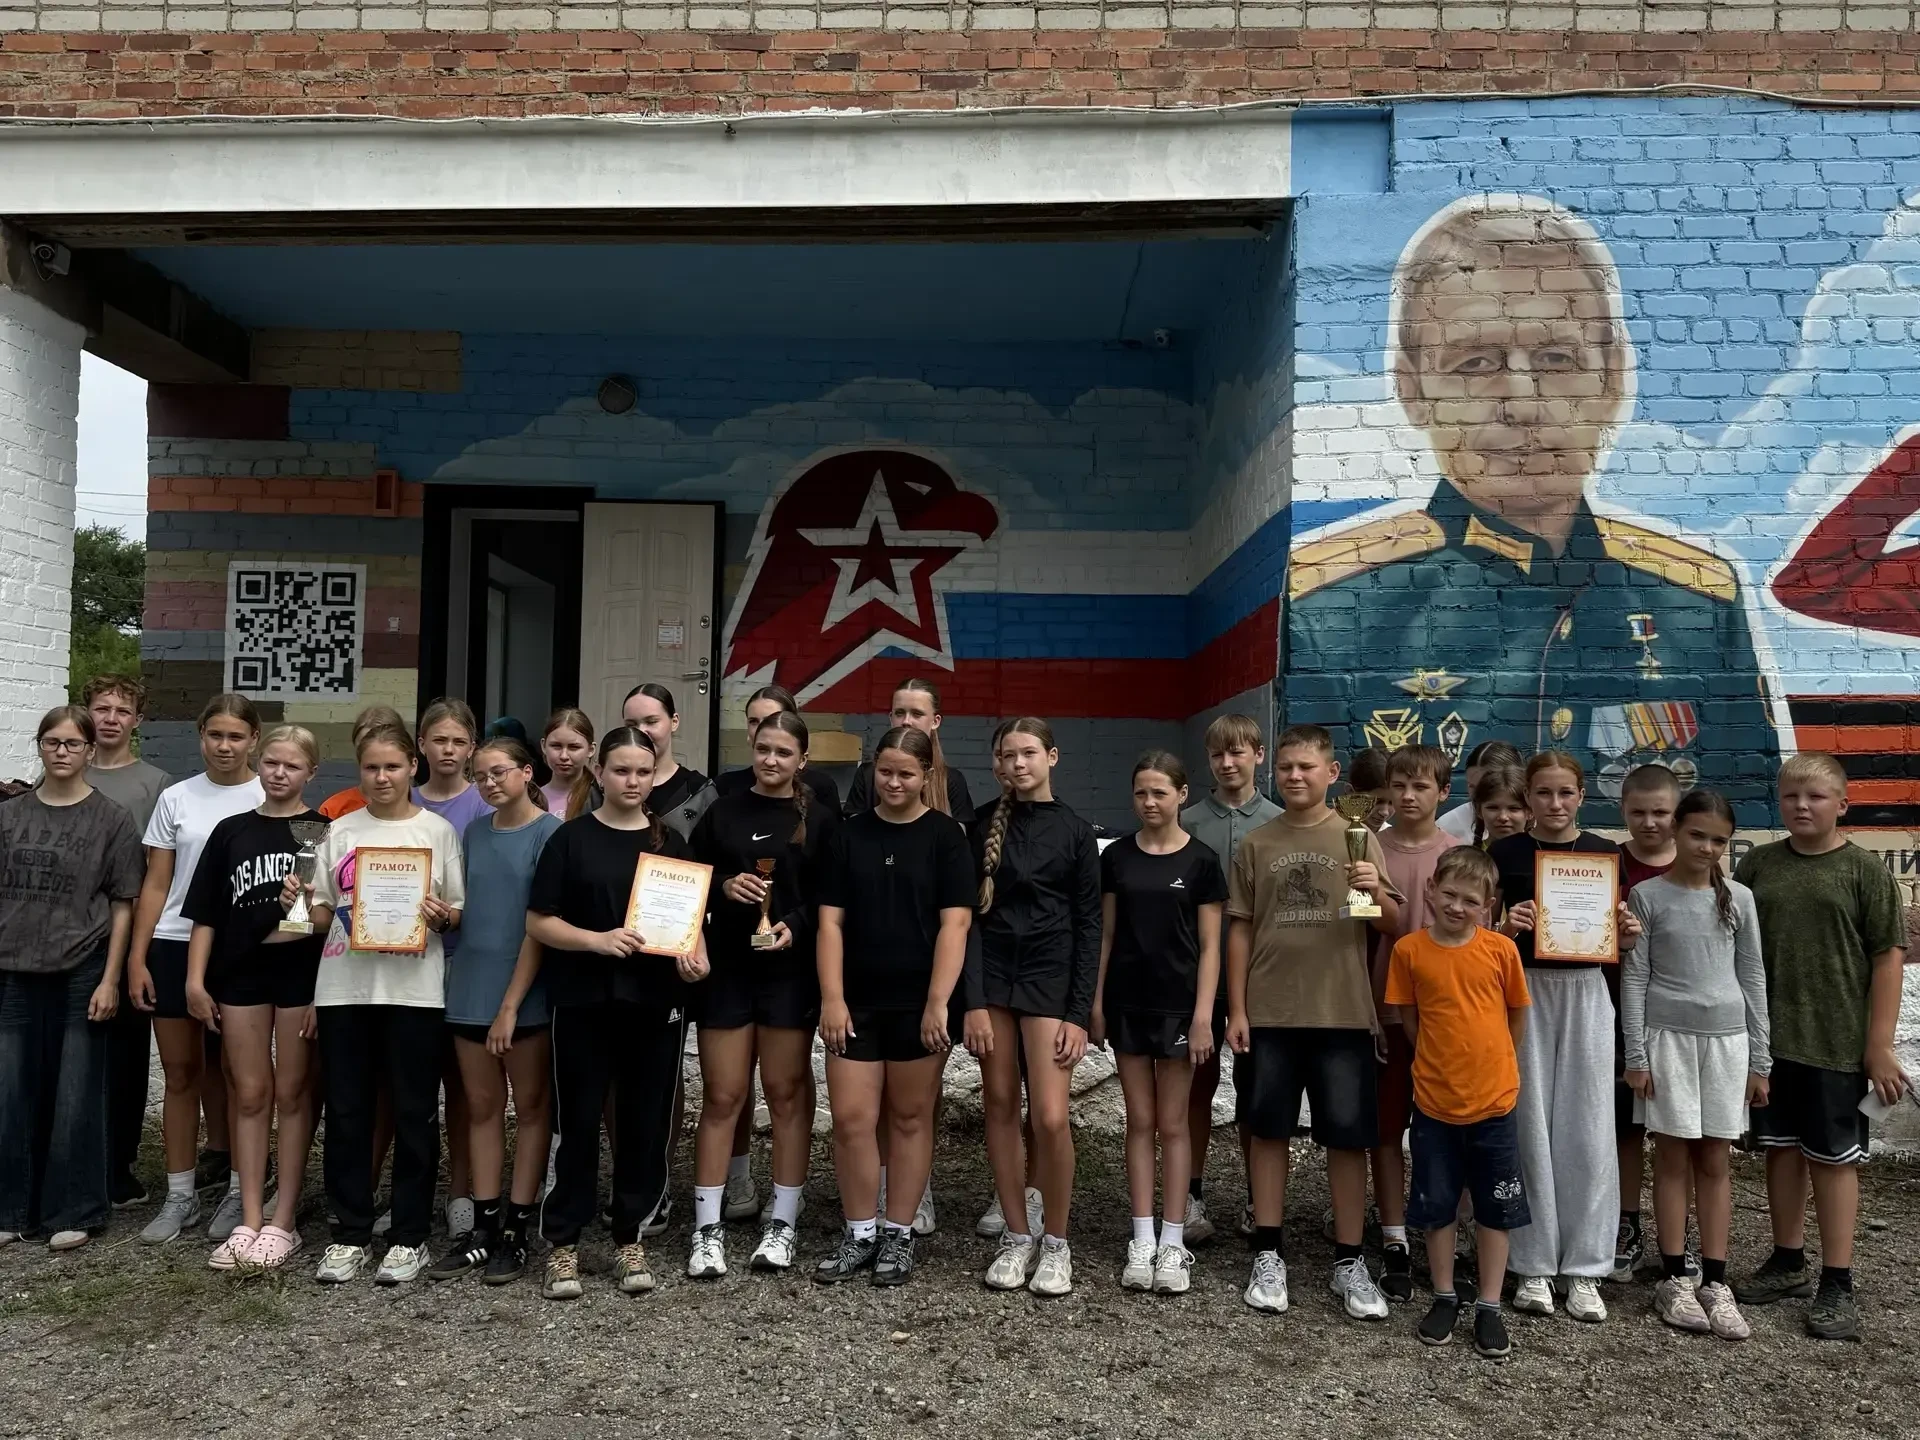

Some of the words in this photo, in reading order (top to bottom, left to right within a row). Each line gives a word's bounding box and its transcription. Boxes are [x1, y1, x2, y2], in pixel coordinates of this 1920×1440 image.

[369, 862, 418, 872] ГРАМОТА
[1270, 852, 1338, 873] COURAGE
[650, 869, 696, 885] ГРАМОТА
[1551, 867, 1603, 878] ГРАМОТА
[1298, 909, 1332, 922] HORSE
